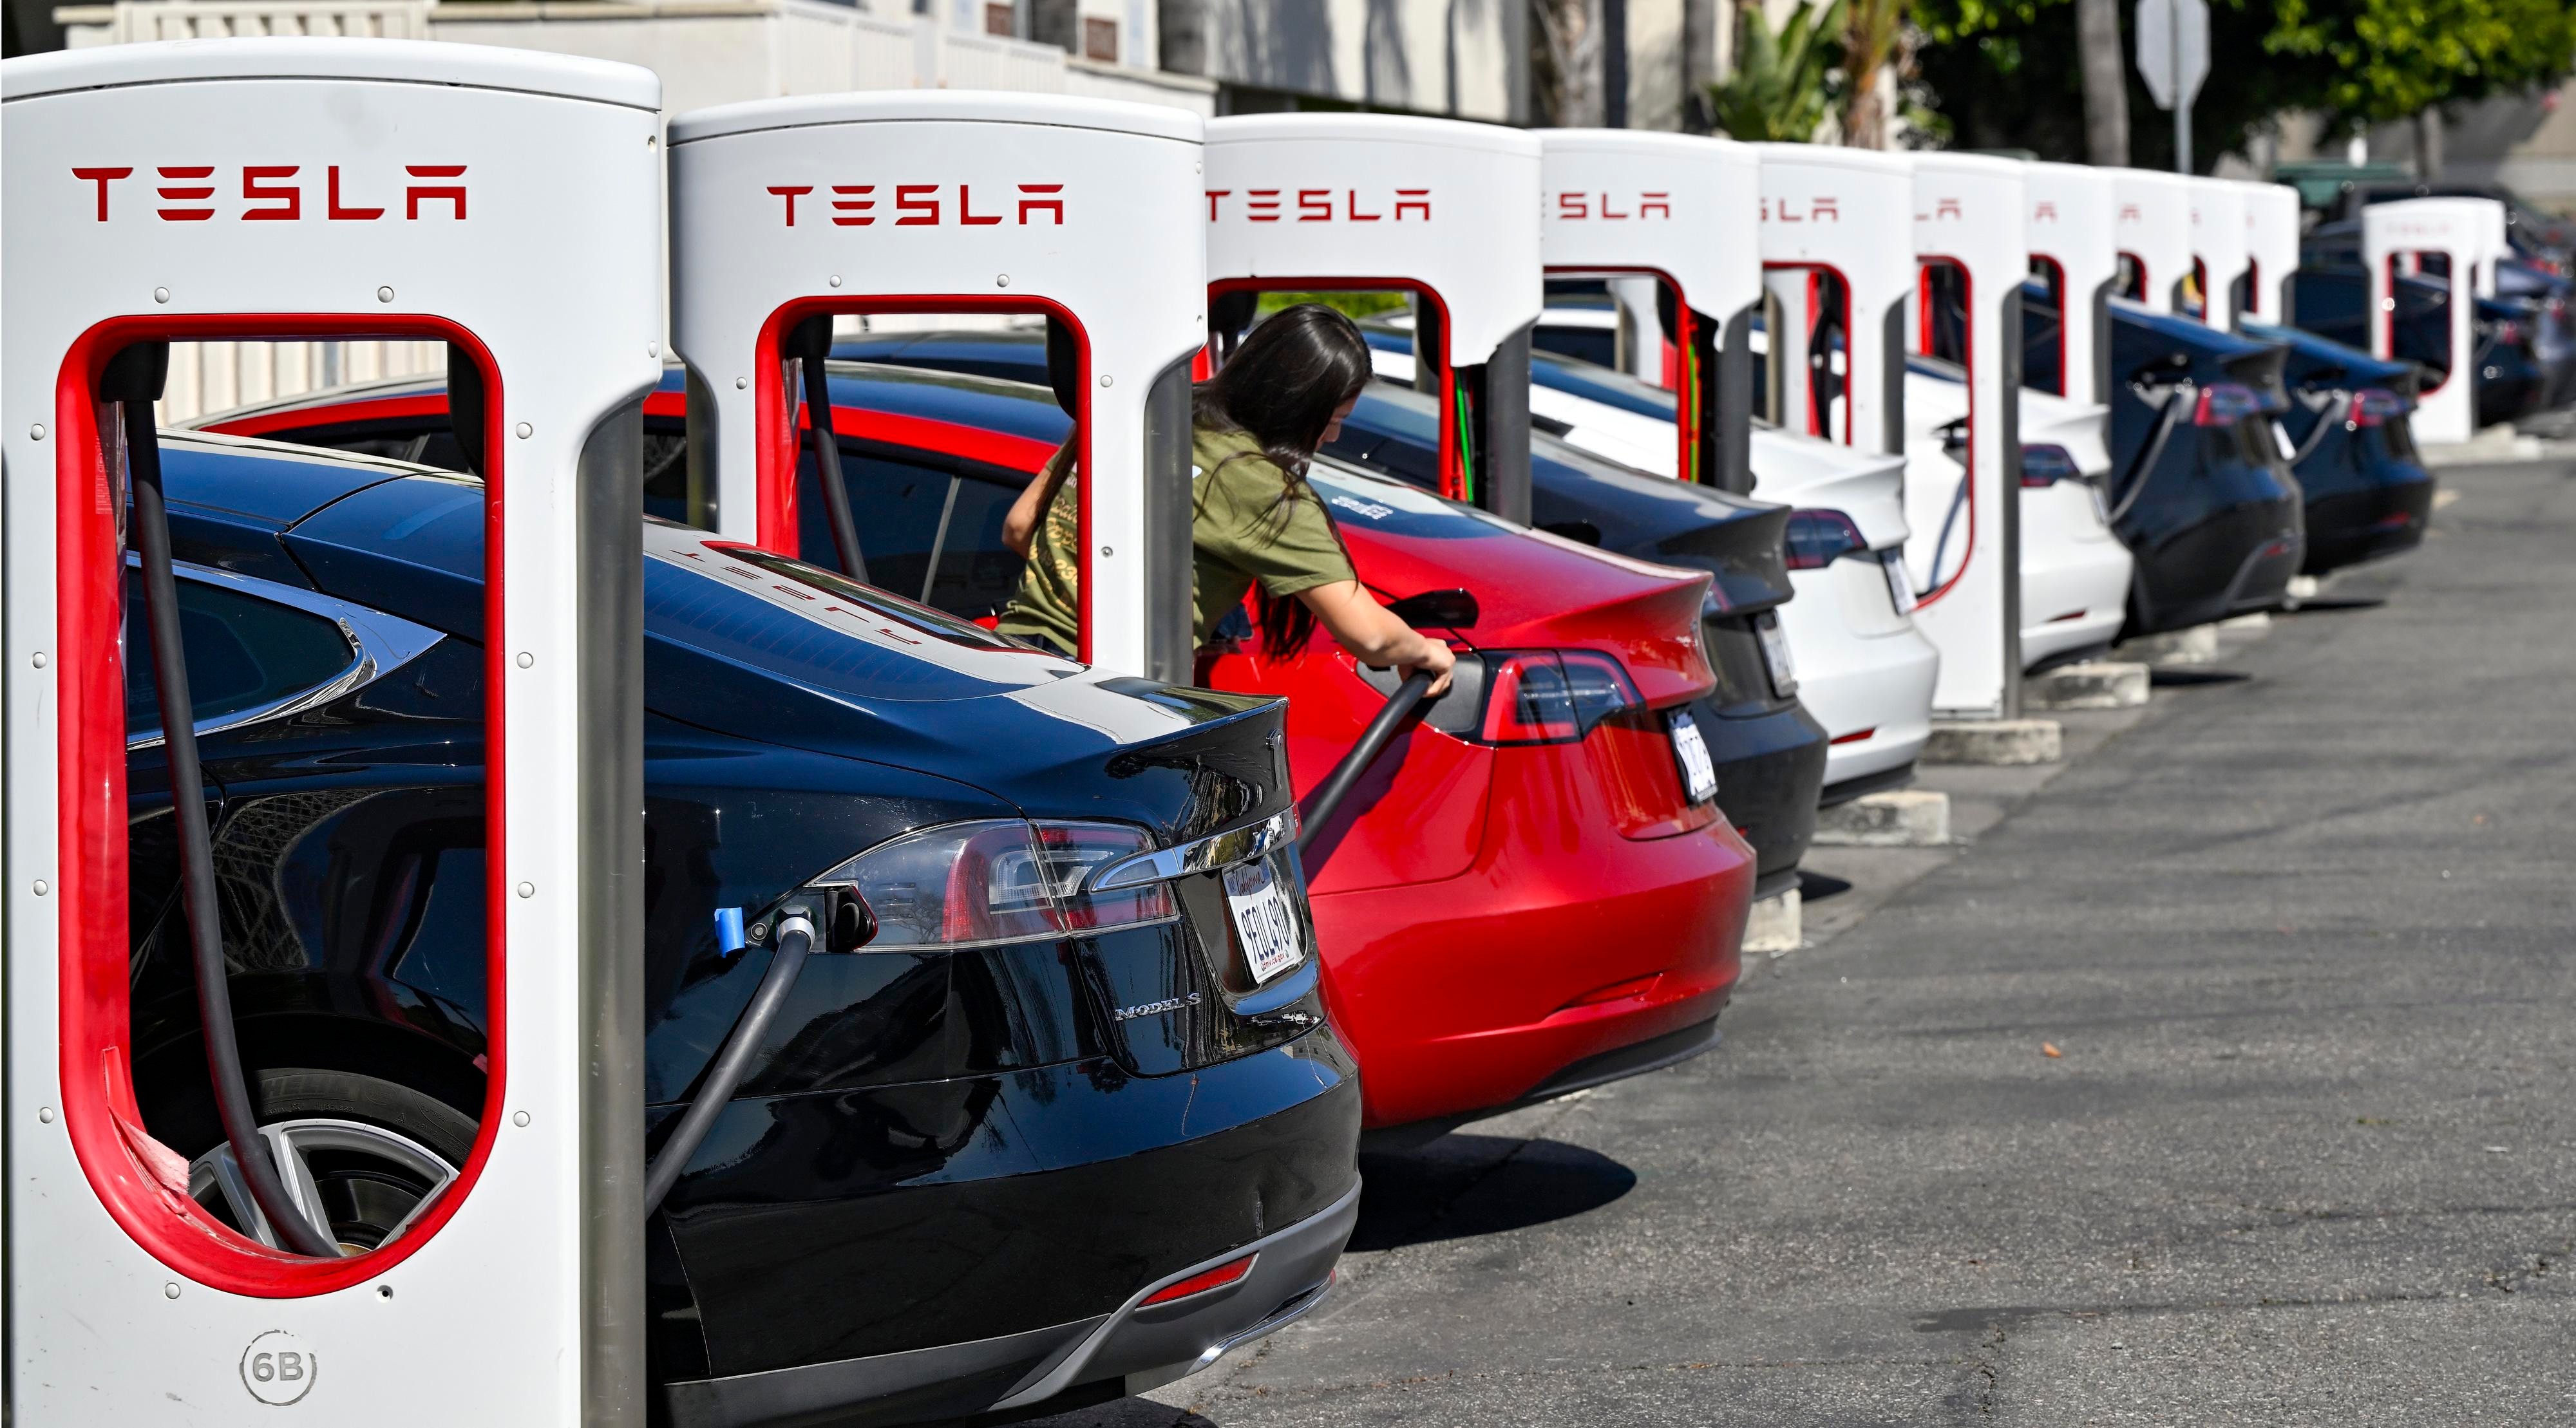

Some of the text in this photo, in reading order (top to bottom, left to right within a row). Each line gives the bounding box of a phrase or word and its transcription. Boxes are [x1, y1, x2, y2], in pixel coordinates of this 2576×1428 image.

[72, 165, 467, 221] TESLA
[766, 184, 1064, 226] TESLA
[1205, 190, 1431, 221] TESLA
[1542, 192, 1670, 219] SLA
[1234, 869, 1265, 900] California
[1262, 952, 1285, 970] dmv.ca.gov
[1114, 992, 1202, 1022] MODEL S
[252, 1351, 304, 1382] 6B
